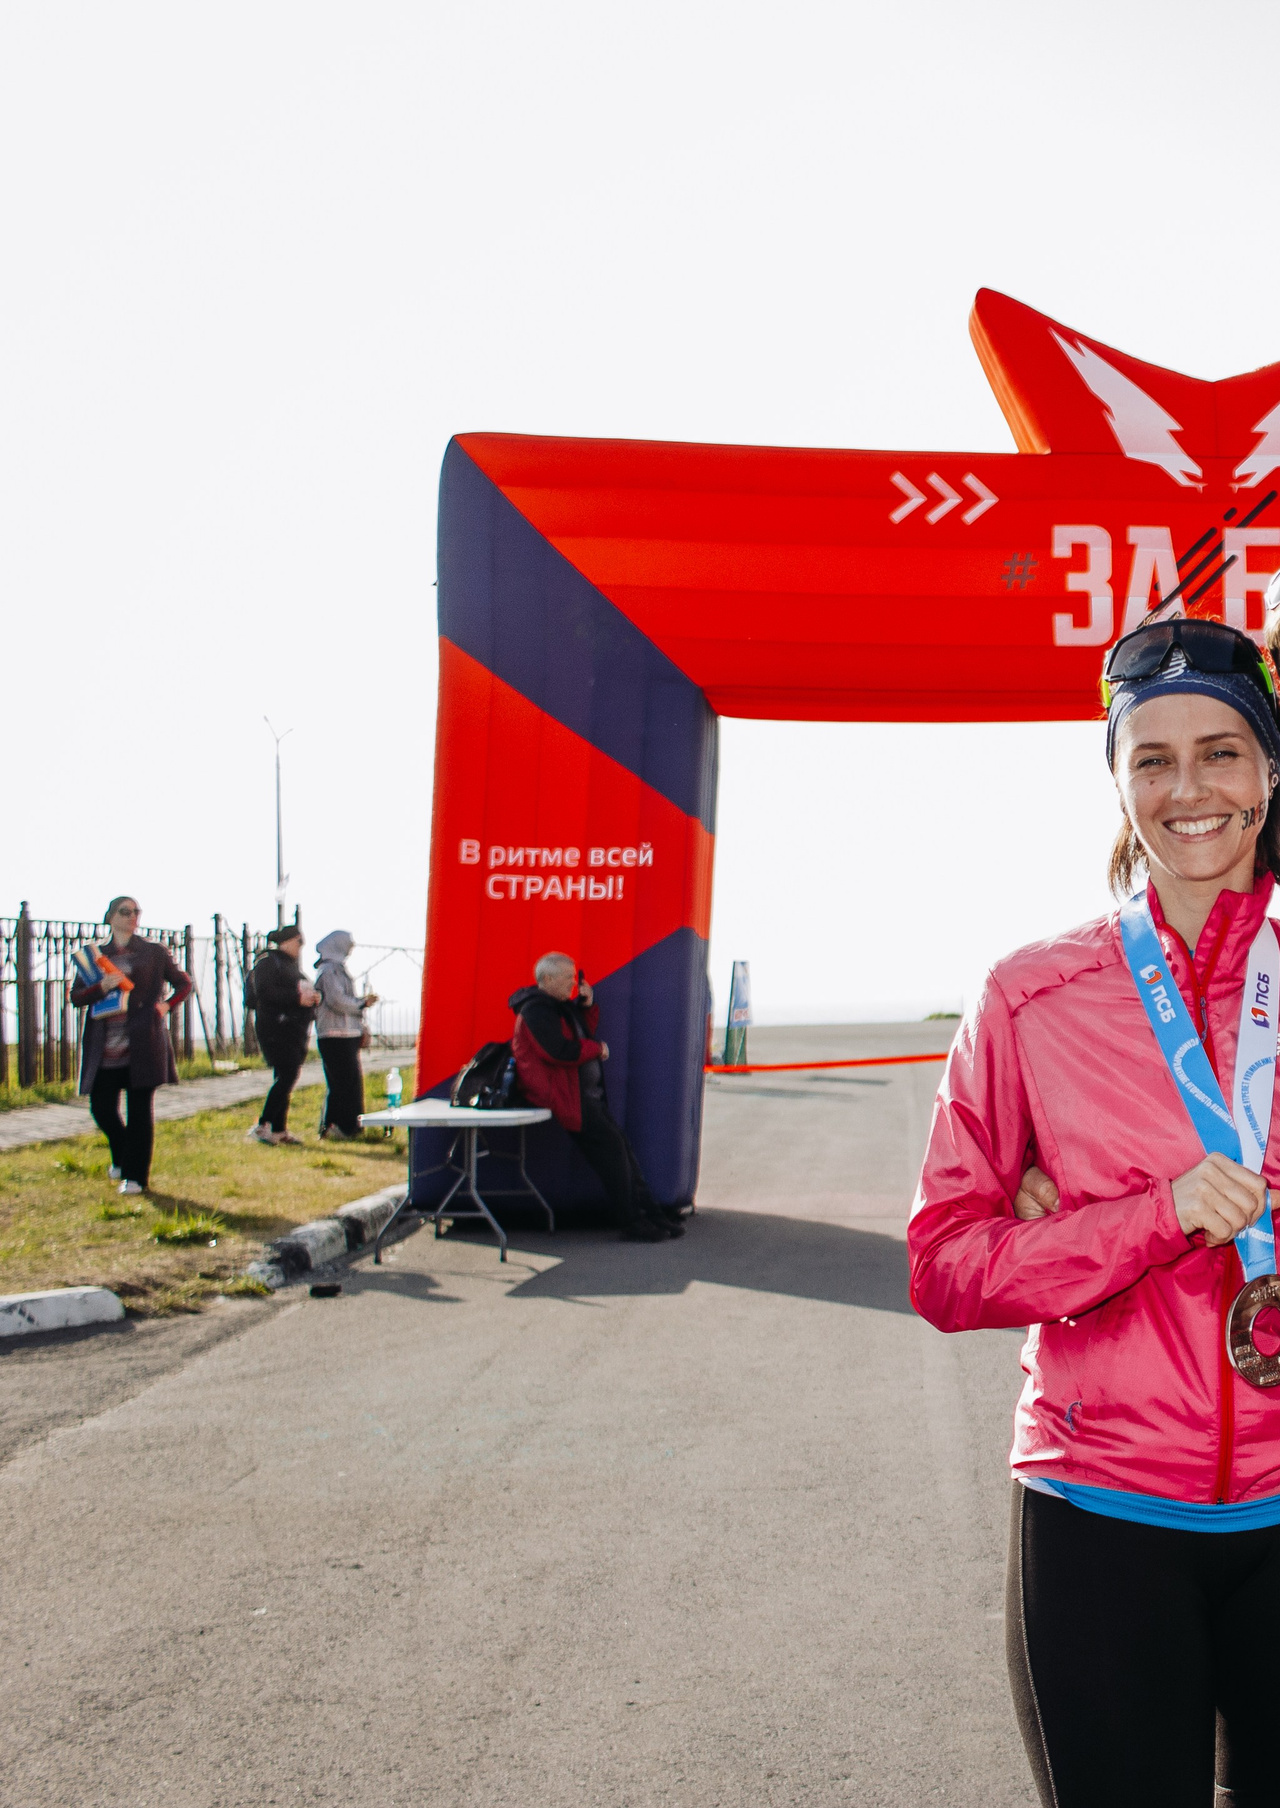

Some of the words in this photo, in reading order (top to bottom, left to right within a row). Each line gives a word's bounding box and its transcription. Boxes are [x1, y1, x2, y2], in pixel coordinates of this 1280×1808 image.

[459, 838, 481, 865] В
[488, 845, 581, 869] ритме
[588, 842, 655, 868] всей
[486, 873, 625, 901] СТРАНЫ!
[1150, 984, 1177, 1024] ПСБ
[1255, 971, 1271, 1007] ПСБ
